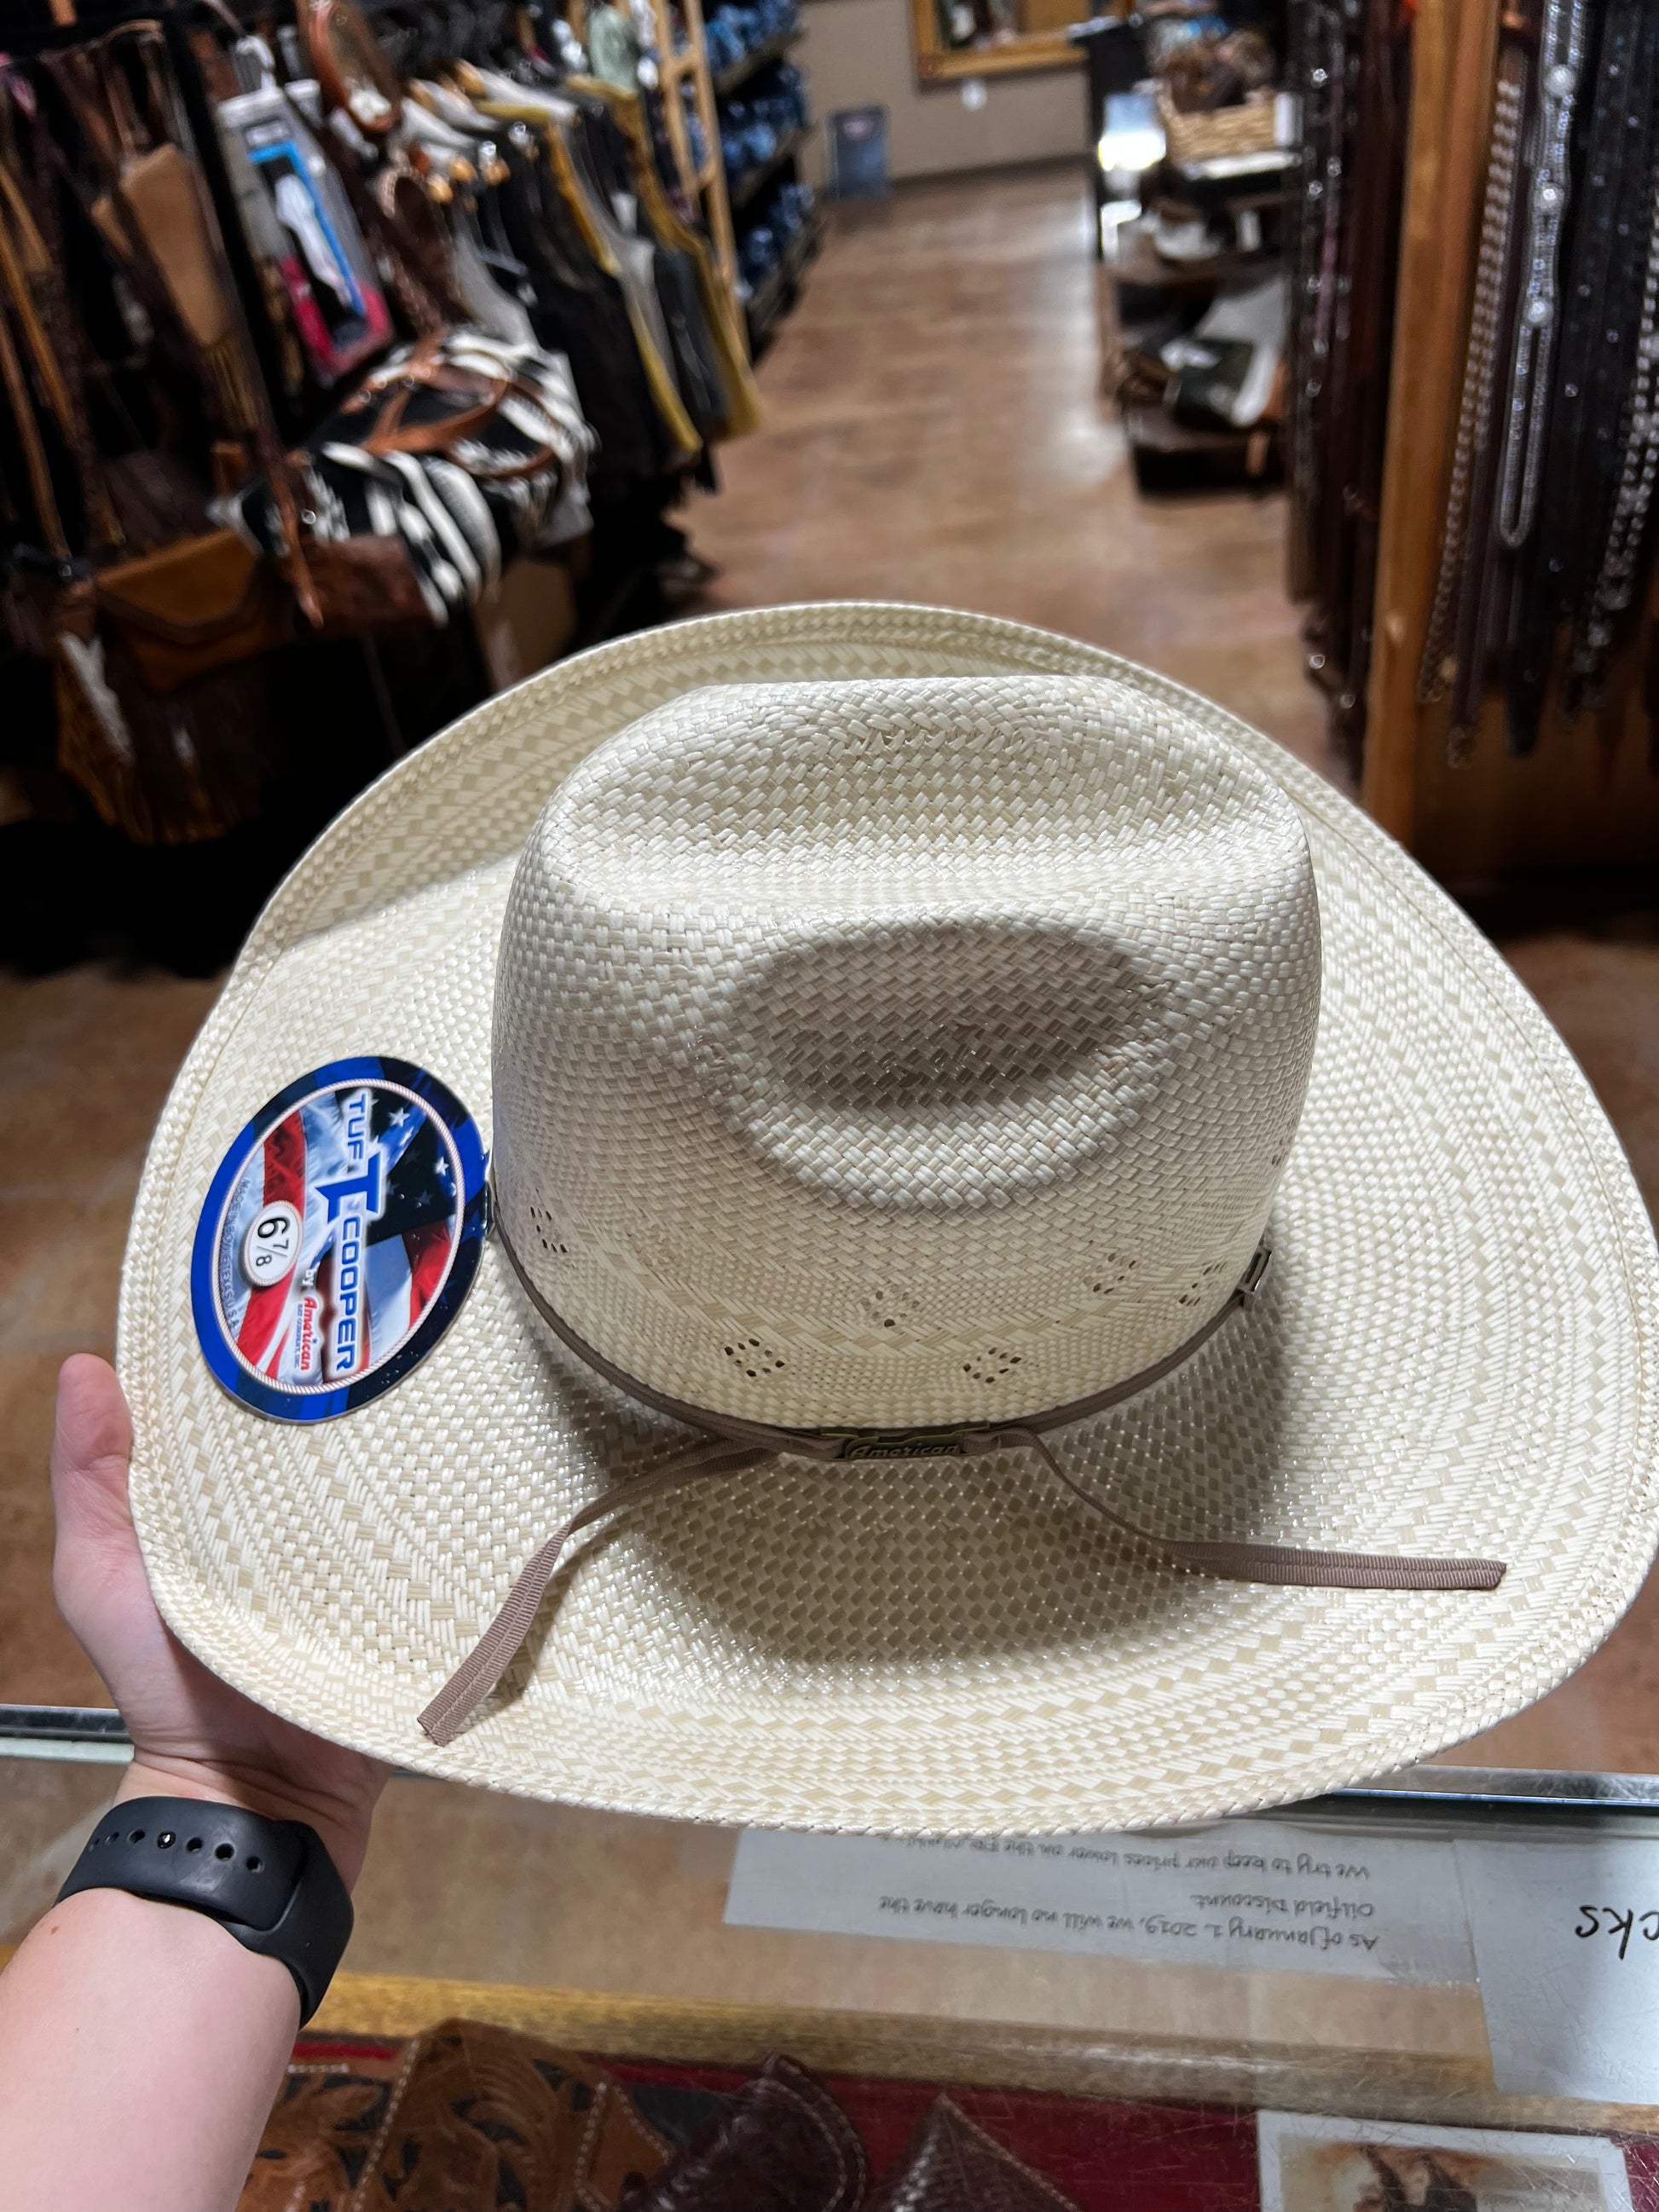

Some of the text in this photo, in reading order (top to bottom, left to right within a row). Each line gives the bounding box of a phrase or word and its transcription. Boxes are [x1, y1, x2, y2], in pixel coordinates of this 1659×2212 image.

[348, 1093, 366, 1160] TUF
[230, 1178, 251, 1210] MADE
[257, 1217, 291, 1239] 6
[336, 1216, 361, 1371] COOPER
[300, 1268, 318, 1371] by American
[849, 1441, 960, 1458] American
[1003, 1839, 1036, 1857] the
[1067, 1845, 1119, 1867] lower
[1123, 1849, 1181, 1871] prices
[1185, 1855, 1219, 1869] our
[1271, 1857, 1292, 1875] to
[1296, 1852, 1332, 1879] try
[1335, 1863, 1371, 1880] We
[879, 1895, 910, 1915] the
[913, 1897, 959, 1919] have
[962, 1897, 1028, 1926] longer
[1031, 1908, 1059, 1922] no
[1292, 1896, 1376, 1919] Oilfield
[1063, 1911, 1103, 1932] will
[1107, 1915, 1135, 1931] we
[1228, 1915, 1324, 1947] January
[1321, 1931, 1344, 1950] of
[1349, 1932, 1380, 1950] As
